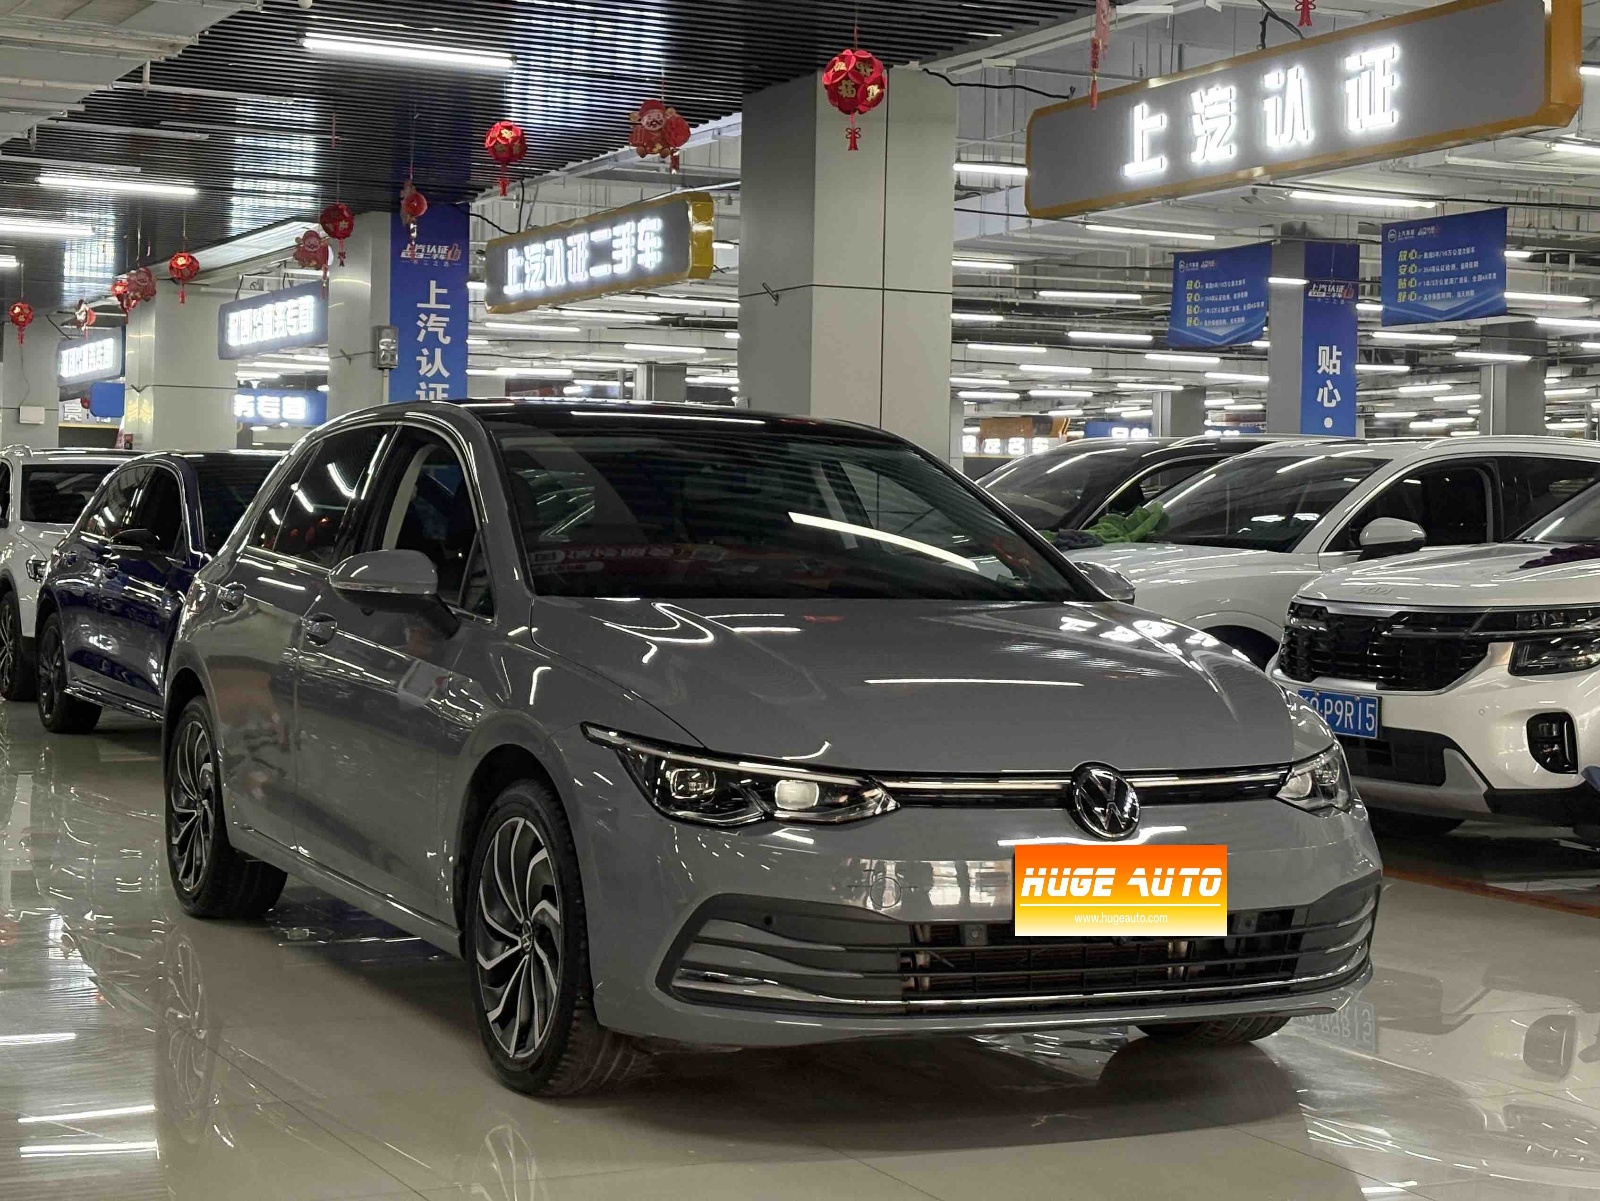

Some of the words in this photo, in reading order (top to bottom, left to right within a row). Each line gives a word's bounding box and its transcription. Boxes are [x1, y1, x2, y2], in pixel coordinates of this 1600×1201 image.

[1123, 44, 1399, 176] 上汽认证
[503, 218, 662, 296] 上汽认证二手车
[416, 280, 451, 400] 上汽认证
